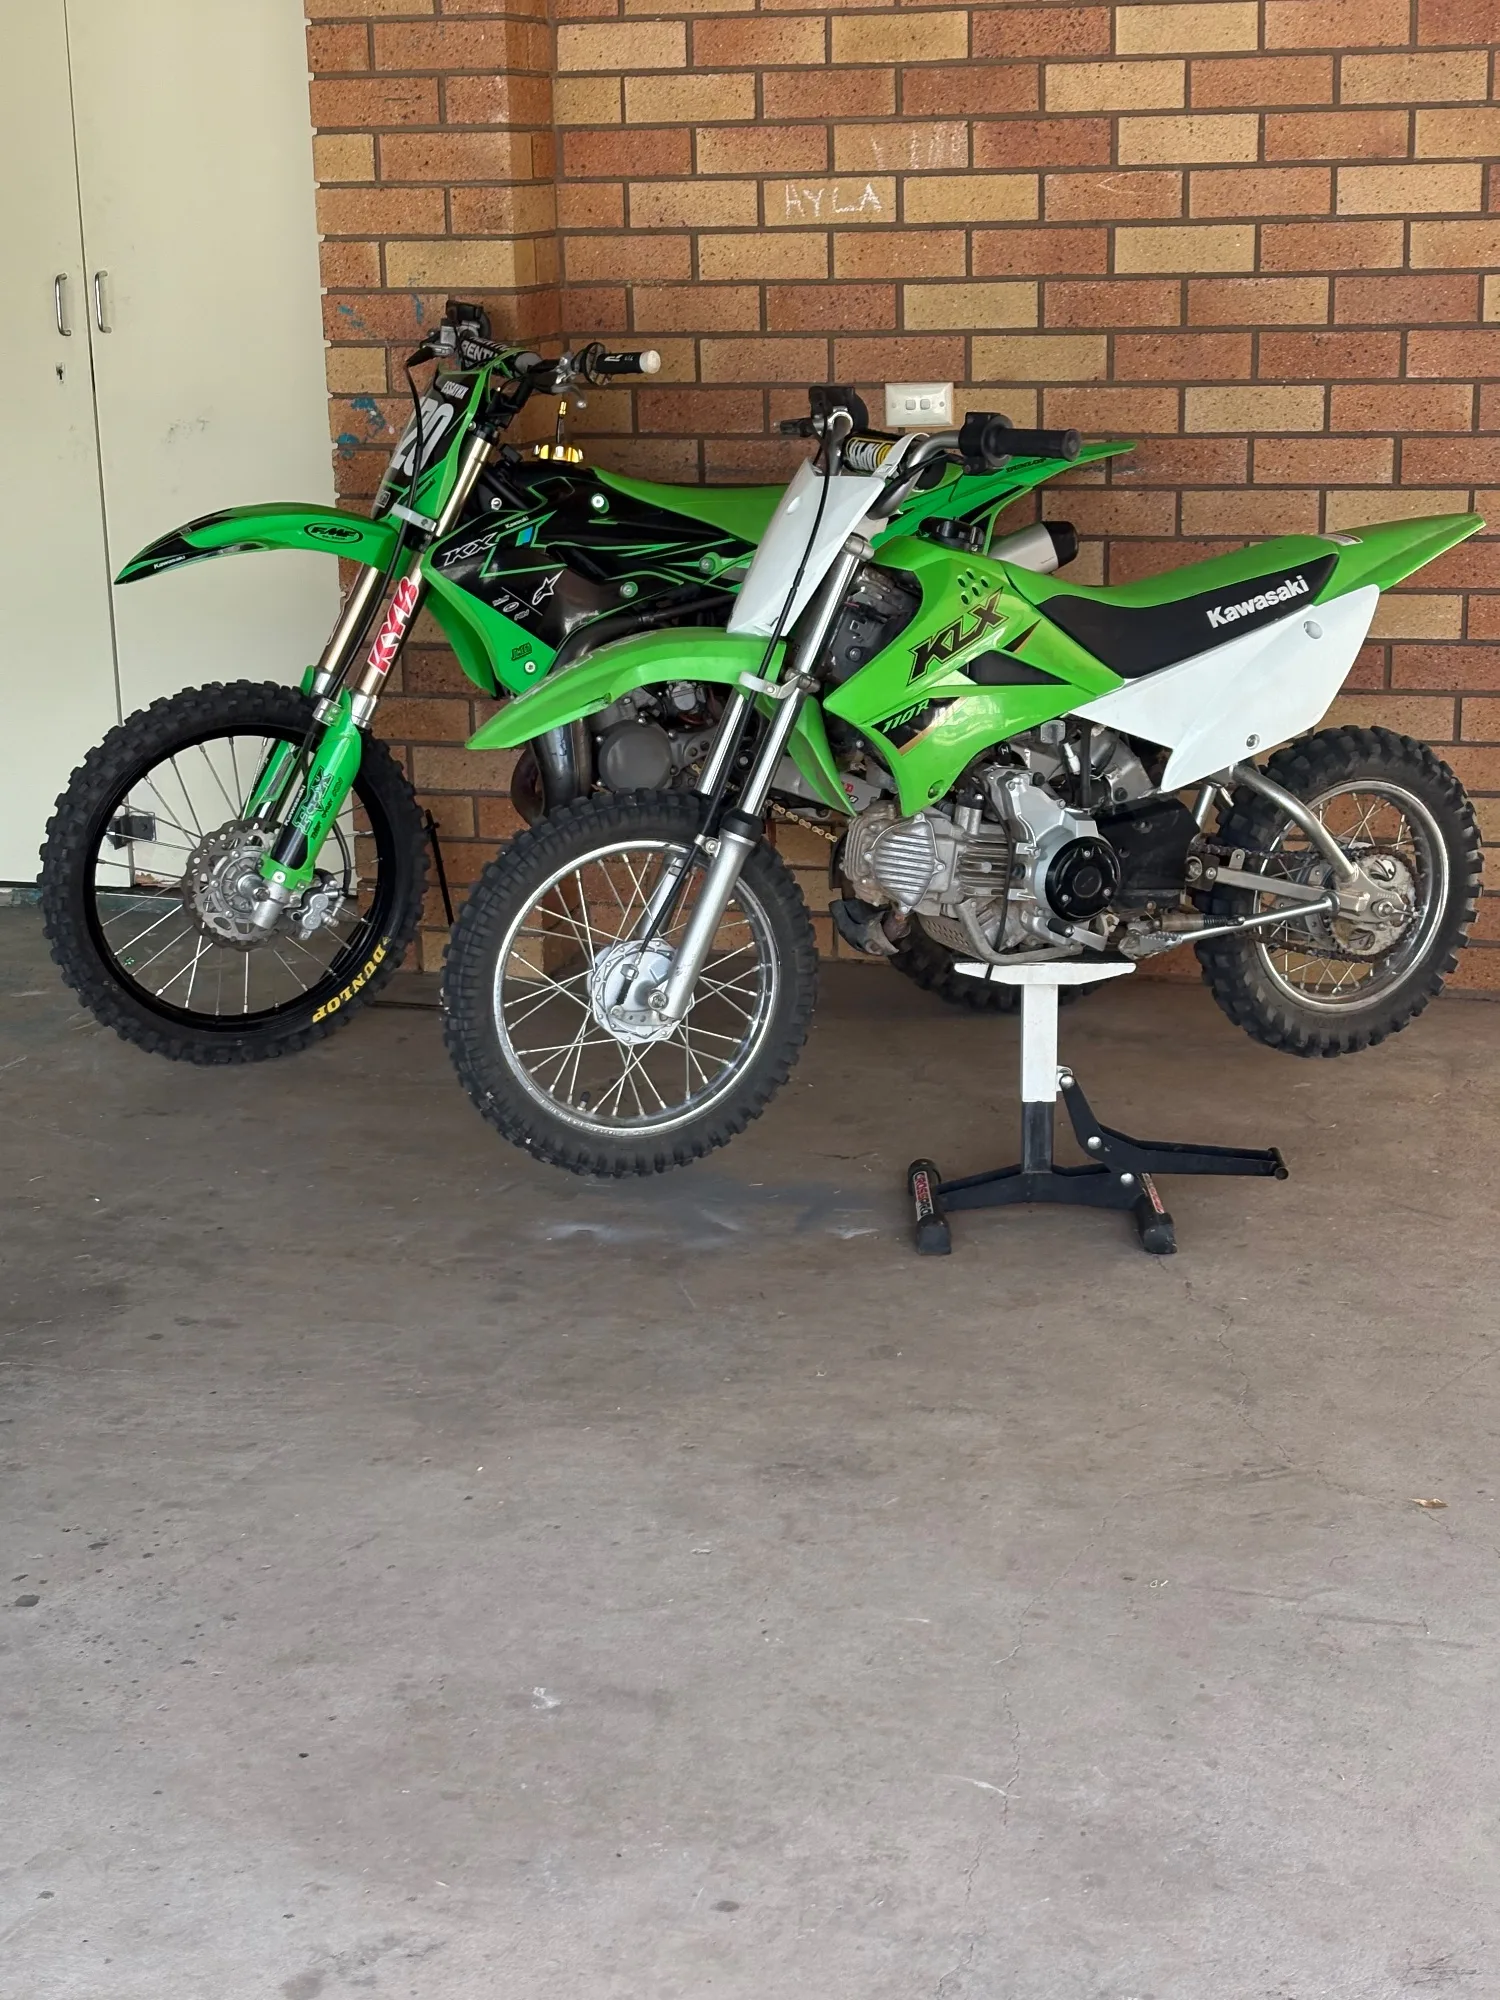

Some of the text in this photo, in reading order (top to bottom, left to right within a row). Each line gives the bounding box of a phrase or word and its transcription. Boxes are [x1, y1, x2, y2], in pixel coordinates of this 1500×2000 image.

[443, 531, 498, 567] KX
[367, 576, 419, 676] KYB
[1206, 575, 1310, 629] Kawasaki
[906, 585, 1010, 687] KLX
[881, 698, 931, 734] 110R
[283, 784, 307, 827] Kawasaki
[312, 943, 387, 1023] DUNLOP
